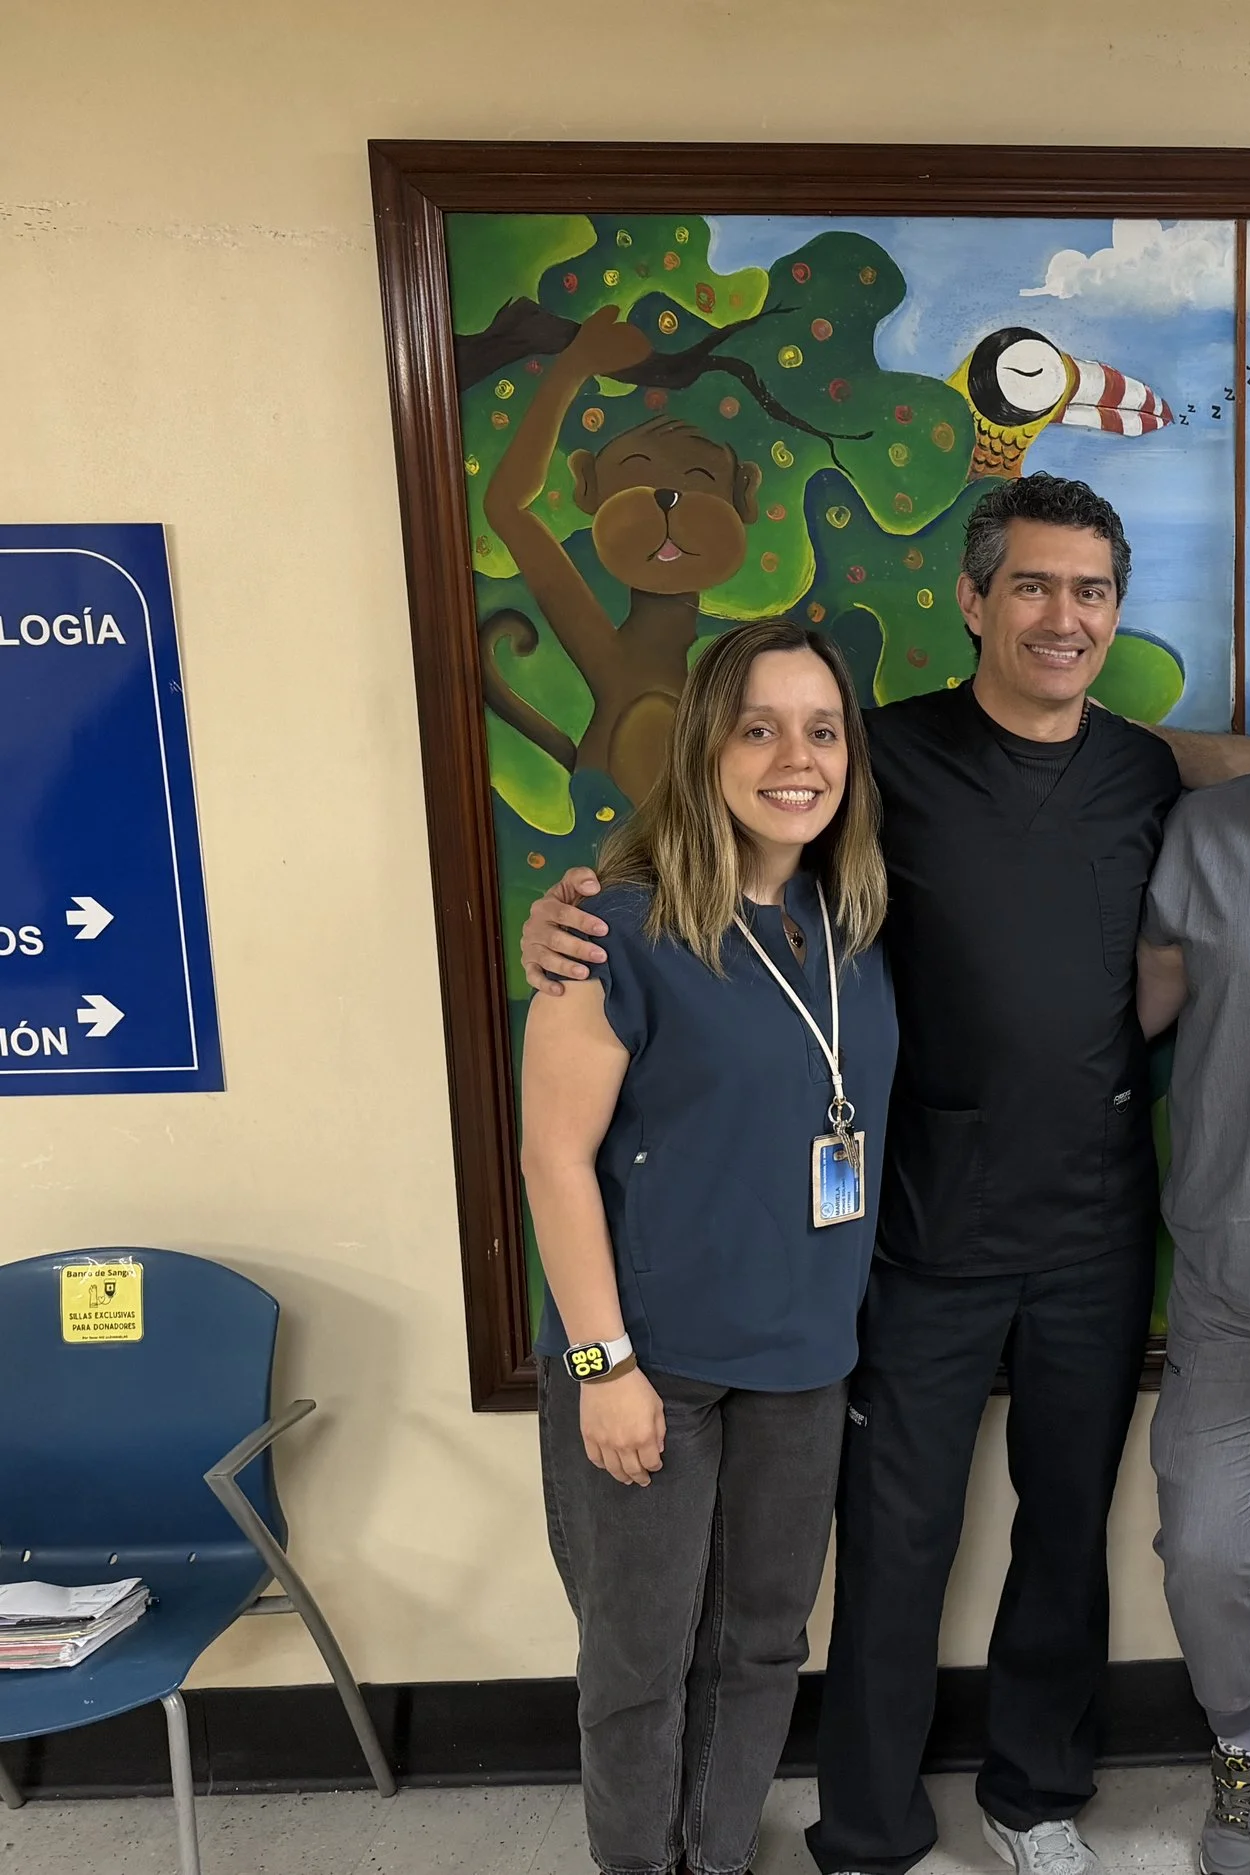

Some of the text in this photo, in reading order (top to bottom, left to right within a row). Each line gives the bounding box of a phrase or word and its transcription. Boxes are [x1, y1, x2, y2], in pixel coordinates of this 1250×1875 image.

[0, 607, 126, 645] LOGÍA
[69, 1311, 135, 1320] SILLAS EXCLUSIVAS
[93, 1322, 136, 1331] DONADORES
[571, 1350, 591, 1376] 08
[586, 1347, 603, 1371] 49
